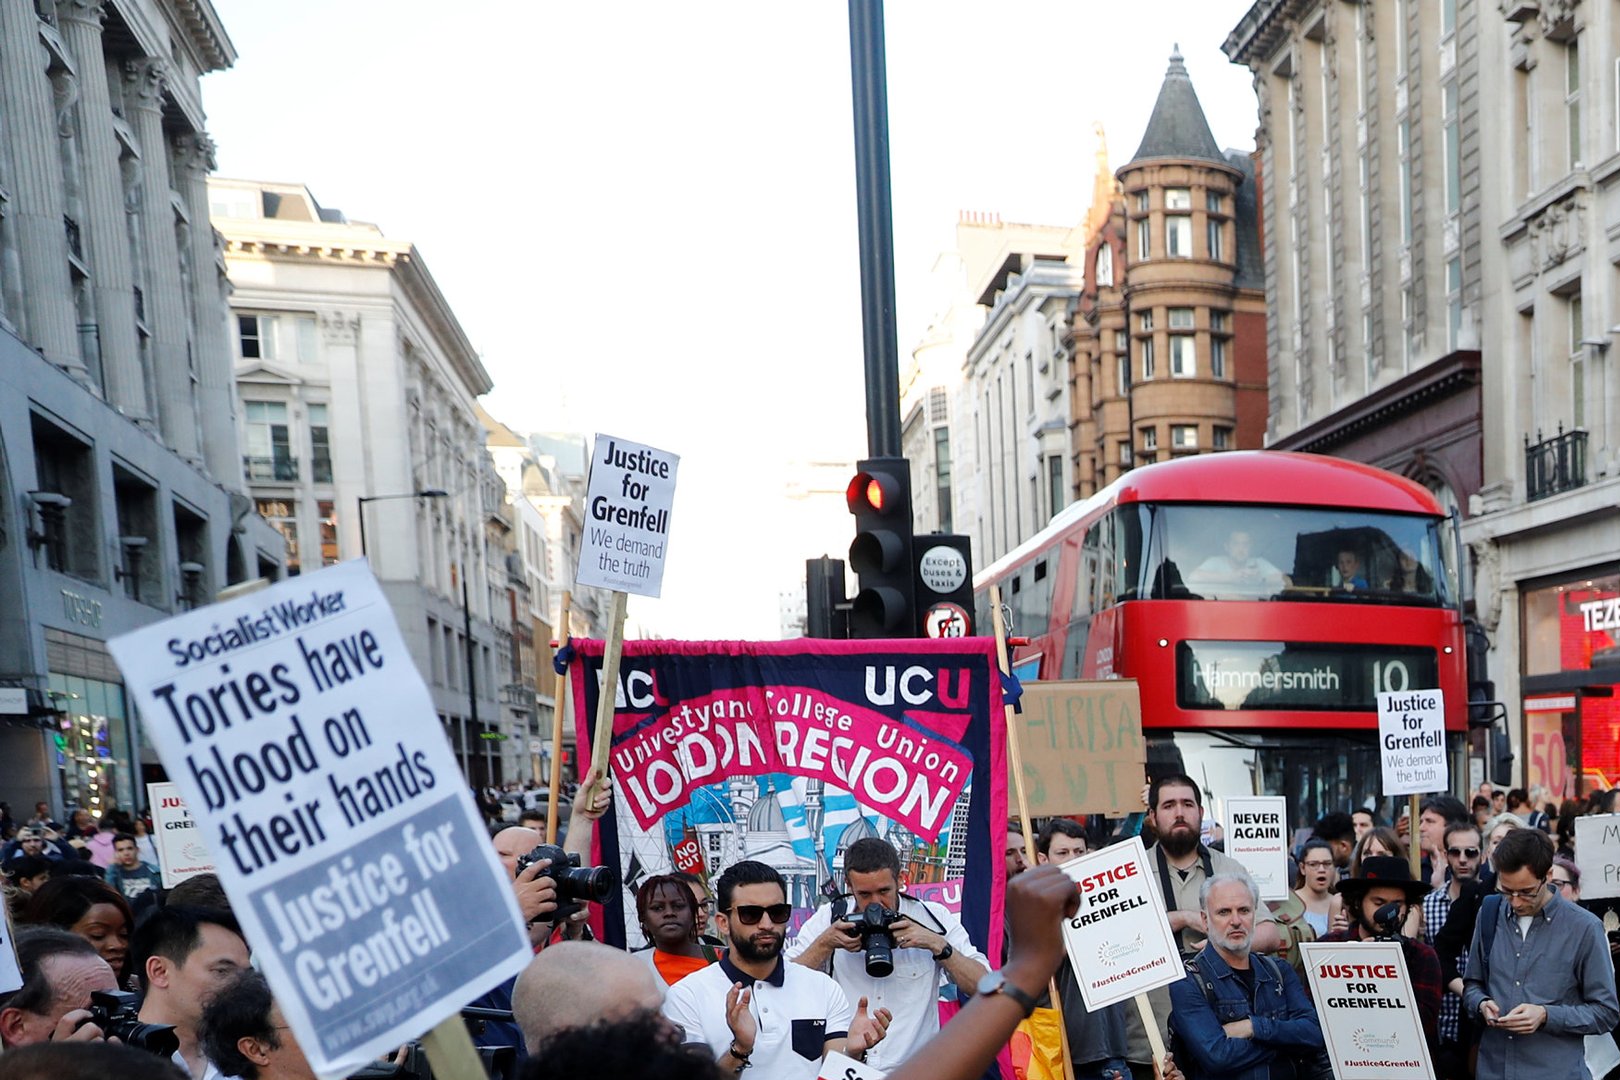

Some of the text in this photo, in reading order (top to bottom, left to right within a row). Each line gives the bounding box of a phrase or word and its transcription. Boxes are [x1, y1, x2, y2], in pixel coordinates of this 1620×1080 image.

[604, 441, 669, 479] Justice
[622, 473, 649, 501] for
[592, 495, 668, 534] Grenfell
[590, 526, 663, 559] We demand
[599, 552, 650, 579] the truth
[923, 569, 962, 577] buses &
[925, 558, 961, 567] Except
[152, 628, 384, 745] Tories have
[865, 665, 970, 709] UCU
[1193, 659, 1410, 698] Hammersmith 10
[1387, 694, 1436, 712] Justice
[1385, 730, 1442, 750] Grenfell
[187, 713, 319, 815] blood
[323, 707, 374, 759] on
[876, 722, 960, 783] Union
[1406, 752, 1442, 767] demand
[774, 720, 952, 832] REGION
[220, 741, 436, 876] their hands
[1233, 813, 1279, 824] NEVER
[1234, 827, 1280, 839] AGAIN
[676, 841, 697, 860] NO
[678, 852, 701, 871] CUT
[1088, 888, 1119, 907] FOR
[1070, 895, 1148, 930] GRENFELL
[1092, 956, 1167, 990] #Justice4Grenfell
[1320, 965, 1398, 979] JUSTICE
[1346, 983, 1378, 994] FOR
[1327, 998, 1406, 1009] GRENFELL
[1344, 1060, 1421, 1068] #Justice4Grenfell
